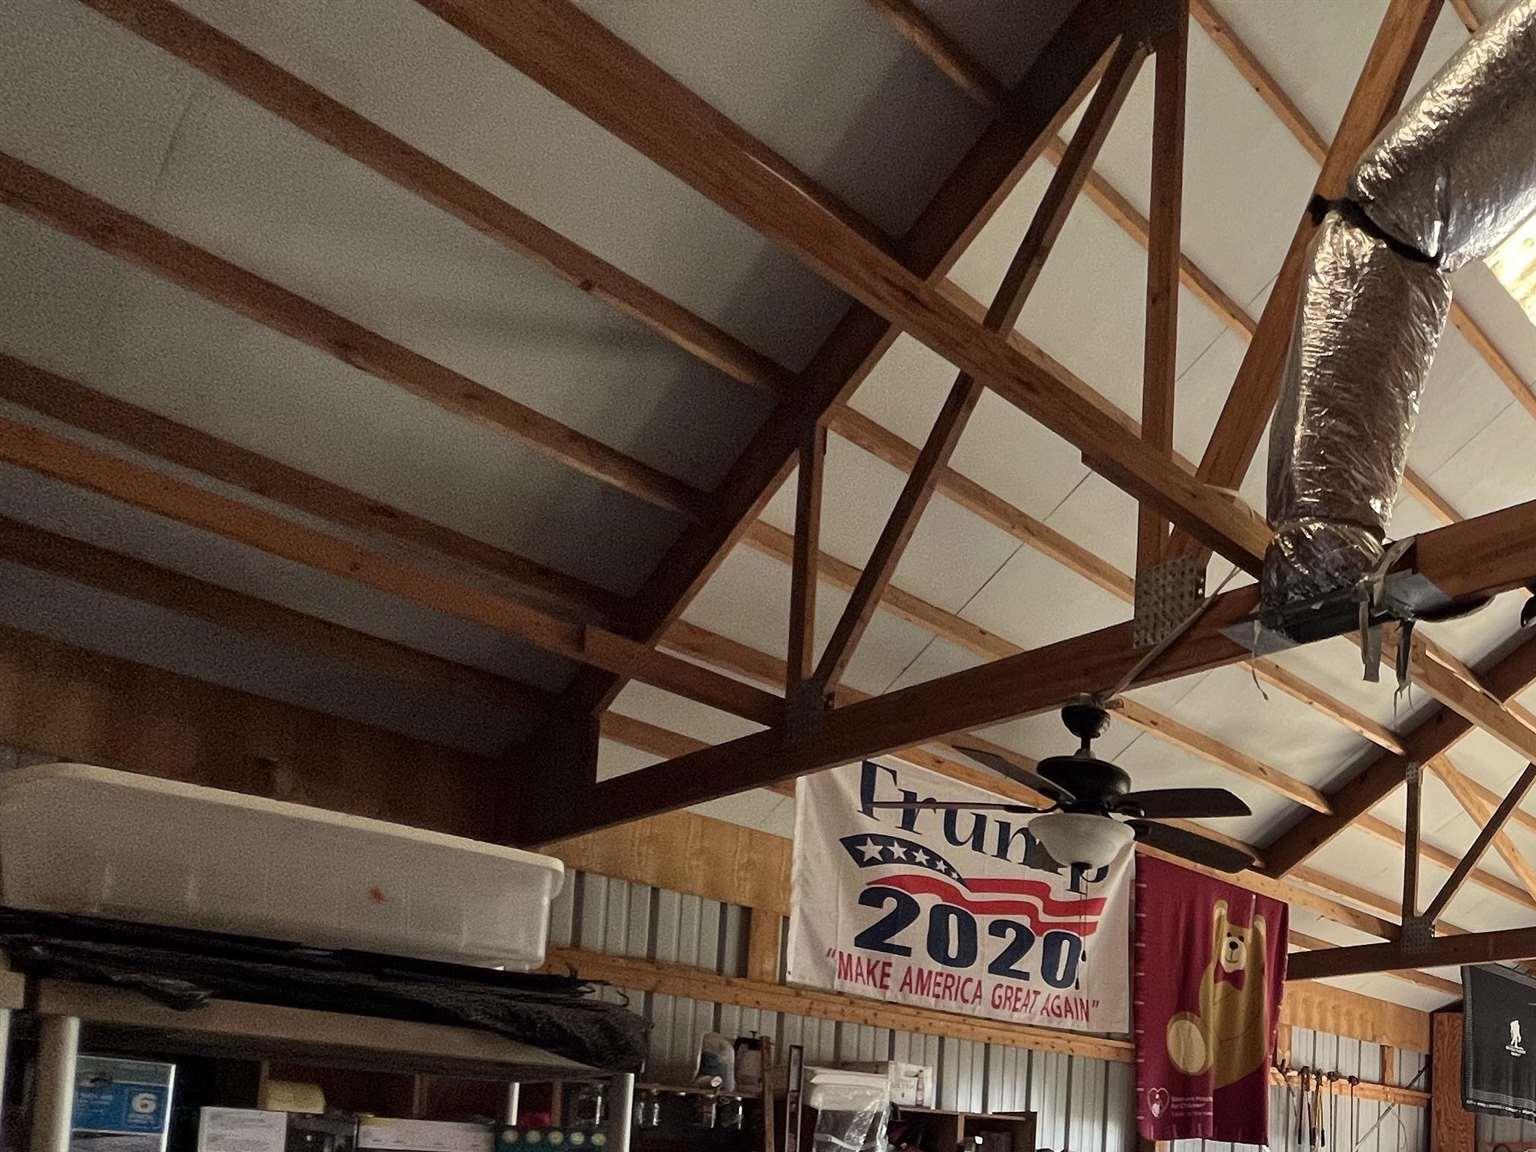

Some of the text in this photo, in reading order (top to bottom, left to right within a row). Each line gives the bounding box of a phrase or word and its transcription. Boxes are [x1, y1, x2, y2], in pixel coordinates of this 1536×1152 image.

[854, 886, 1082, 989] 2020
[899, 966, 983, 1006] AMERICA
[991, 983, 1041, 1014] GREAT
